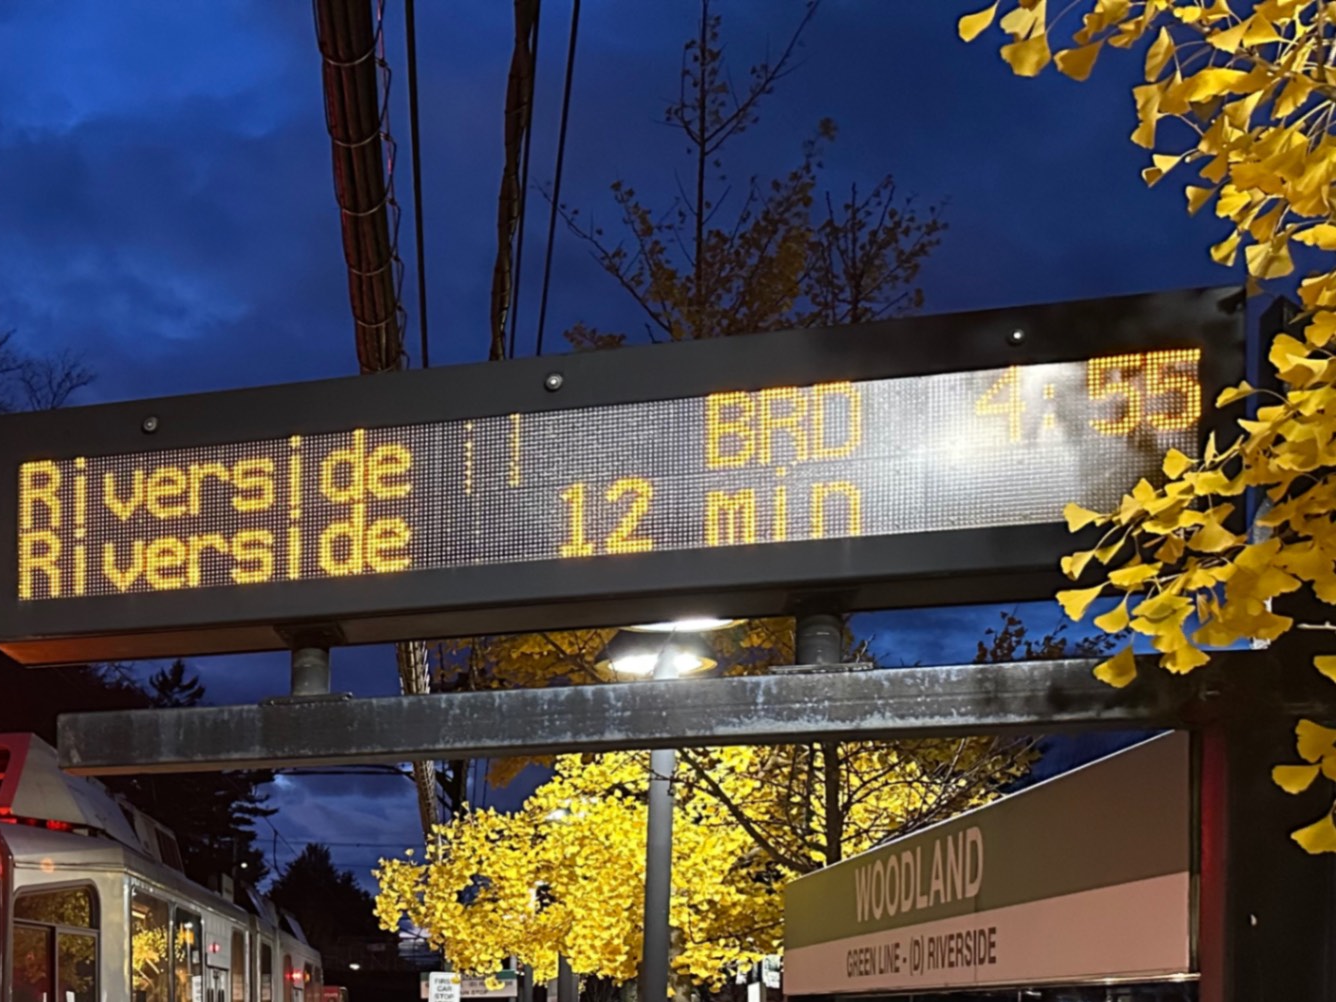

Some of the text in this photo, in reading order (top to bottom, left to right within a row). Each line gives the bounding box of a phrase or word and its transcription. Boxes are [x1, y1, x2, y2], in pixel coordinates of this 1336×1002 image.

[18, 348, 1202, 530] Riverside BRD 4:55
[18, 466, 863, 600] Riverside 12 min
[855, 826, 983, 923] WOODLAND
[846, 948, 876, 979] GREEN
[878, 942, 900, 975] LINE
[910, 935, 924, 976] (D)
[927, 926, 997, 970] RIVERSIDE
